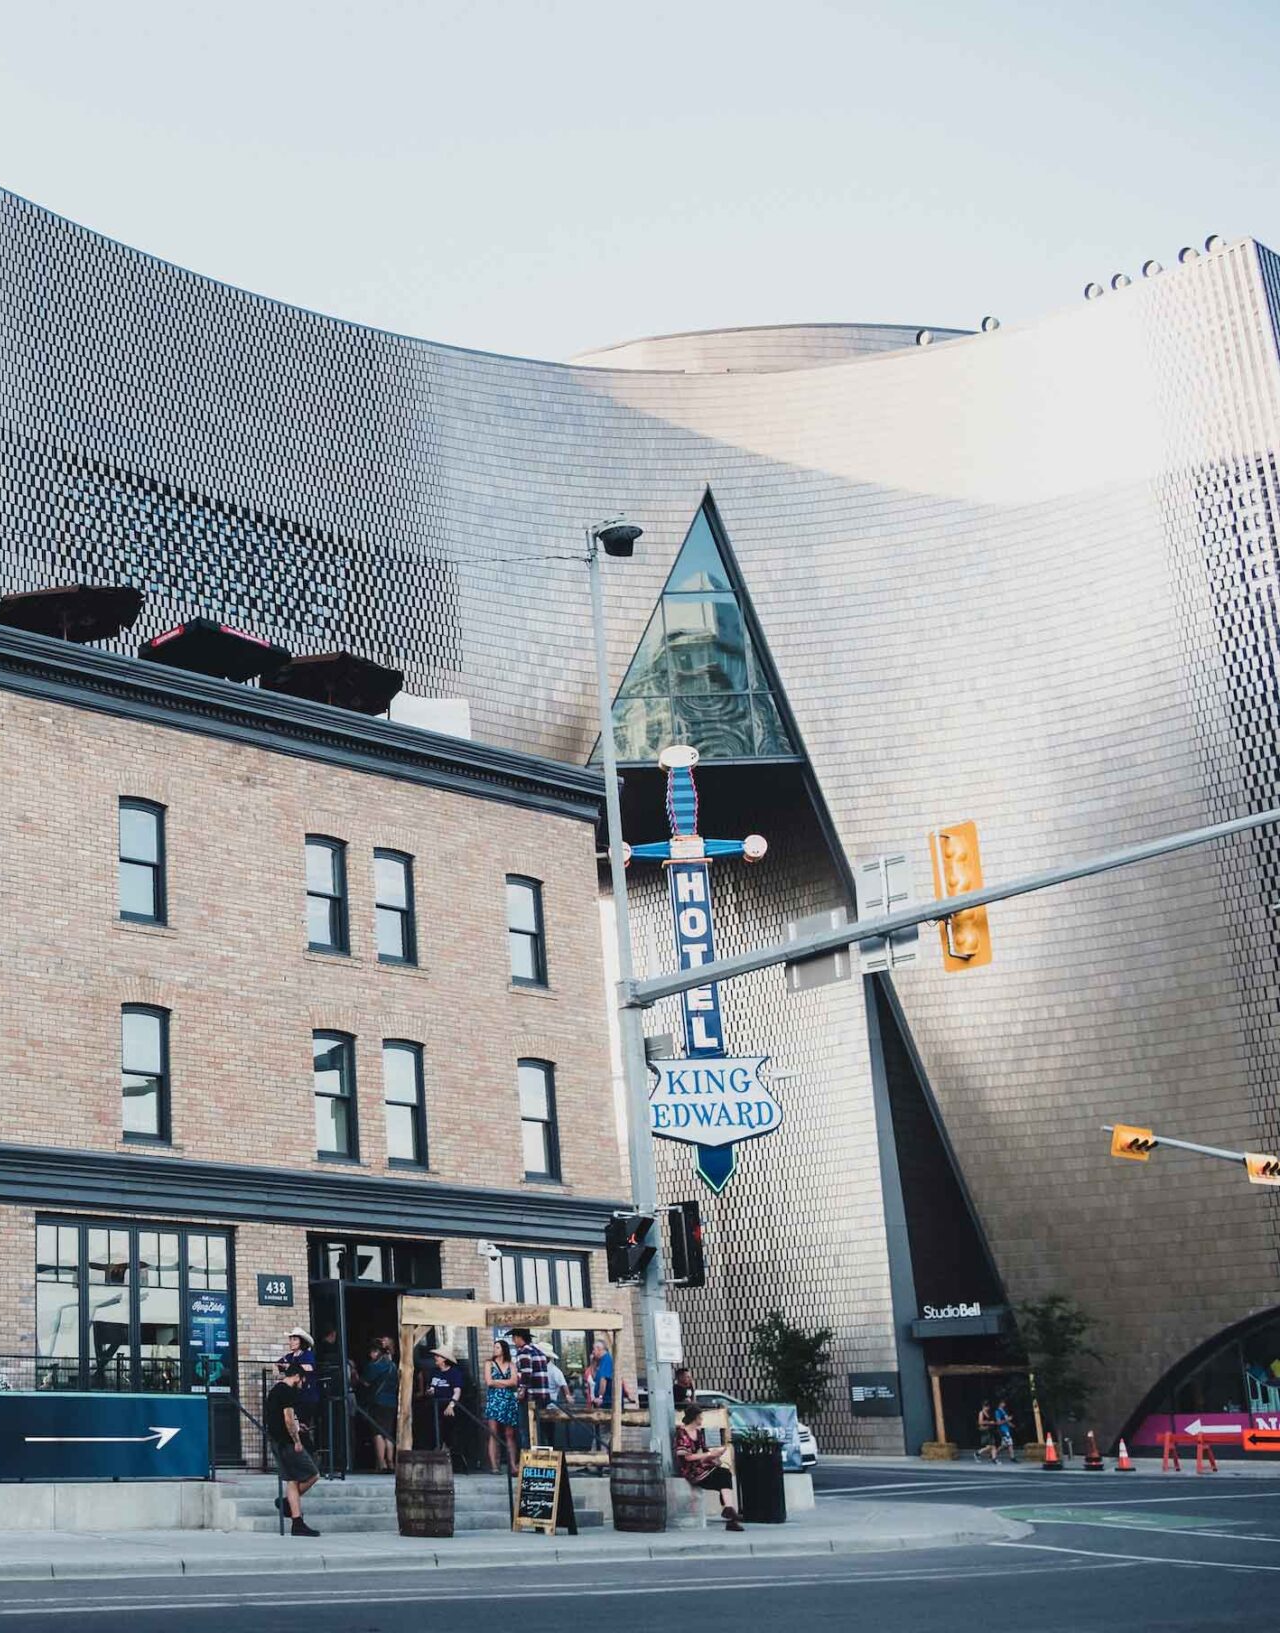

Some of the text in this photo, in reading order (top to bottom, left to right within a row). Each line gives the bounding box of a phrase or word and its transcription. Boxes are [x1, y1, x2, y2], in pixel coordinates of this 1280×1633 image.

[676, 872, 719, 1049] HOTEL
[666, 1067, 754, 1095] KING
[650, 1099, 775, 1130] EDWARD
[265, 1281, 287, 1295] 438
[923, 1302, 982, 1320] StudioBell
